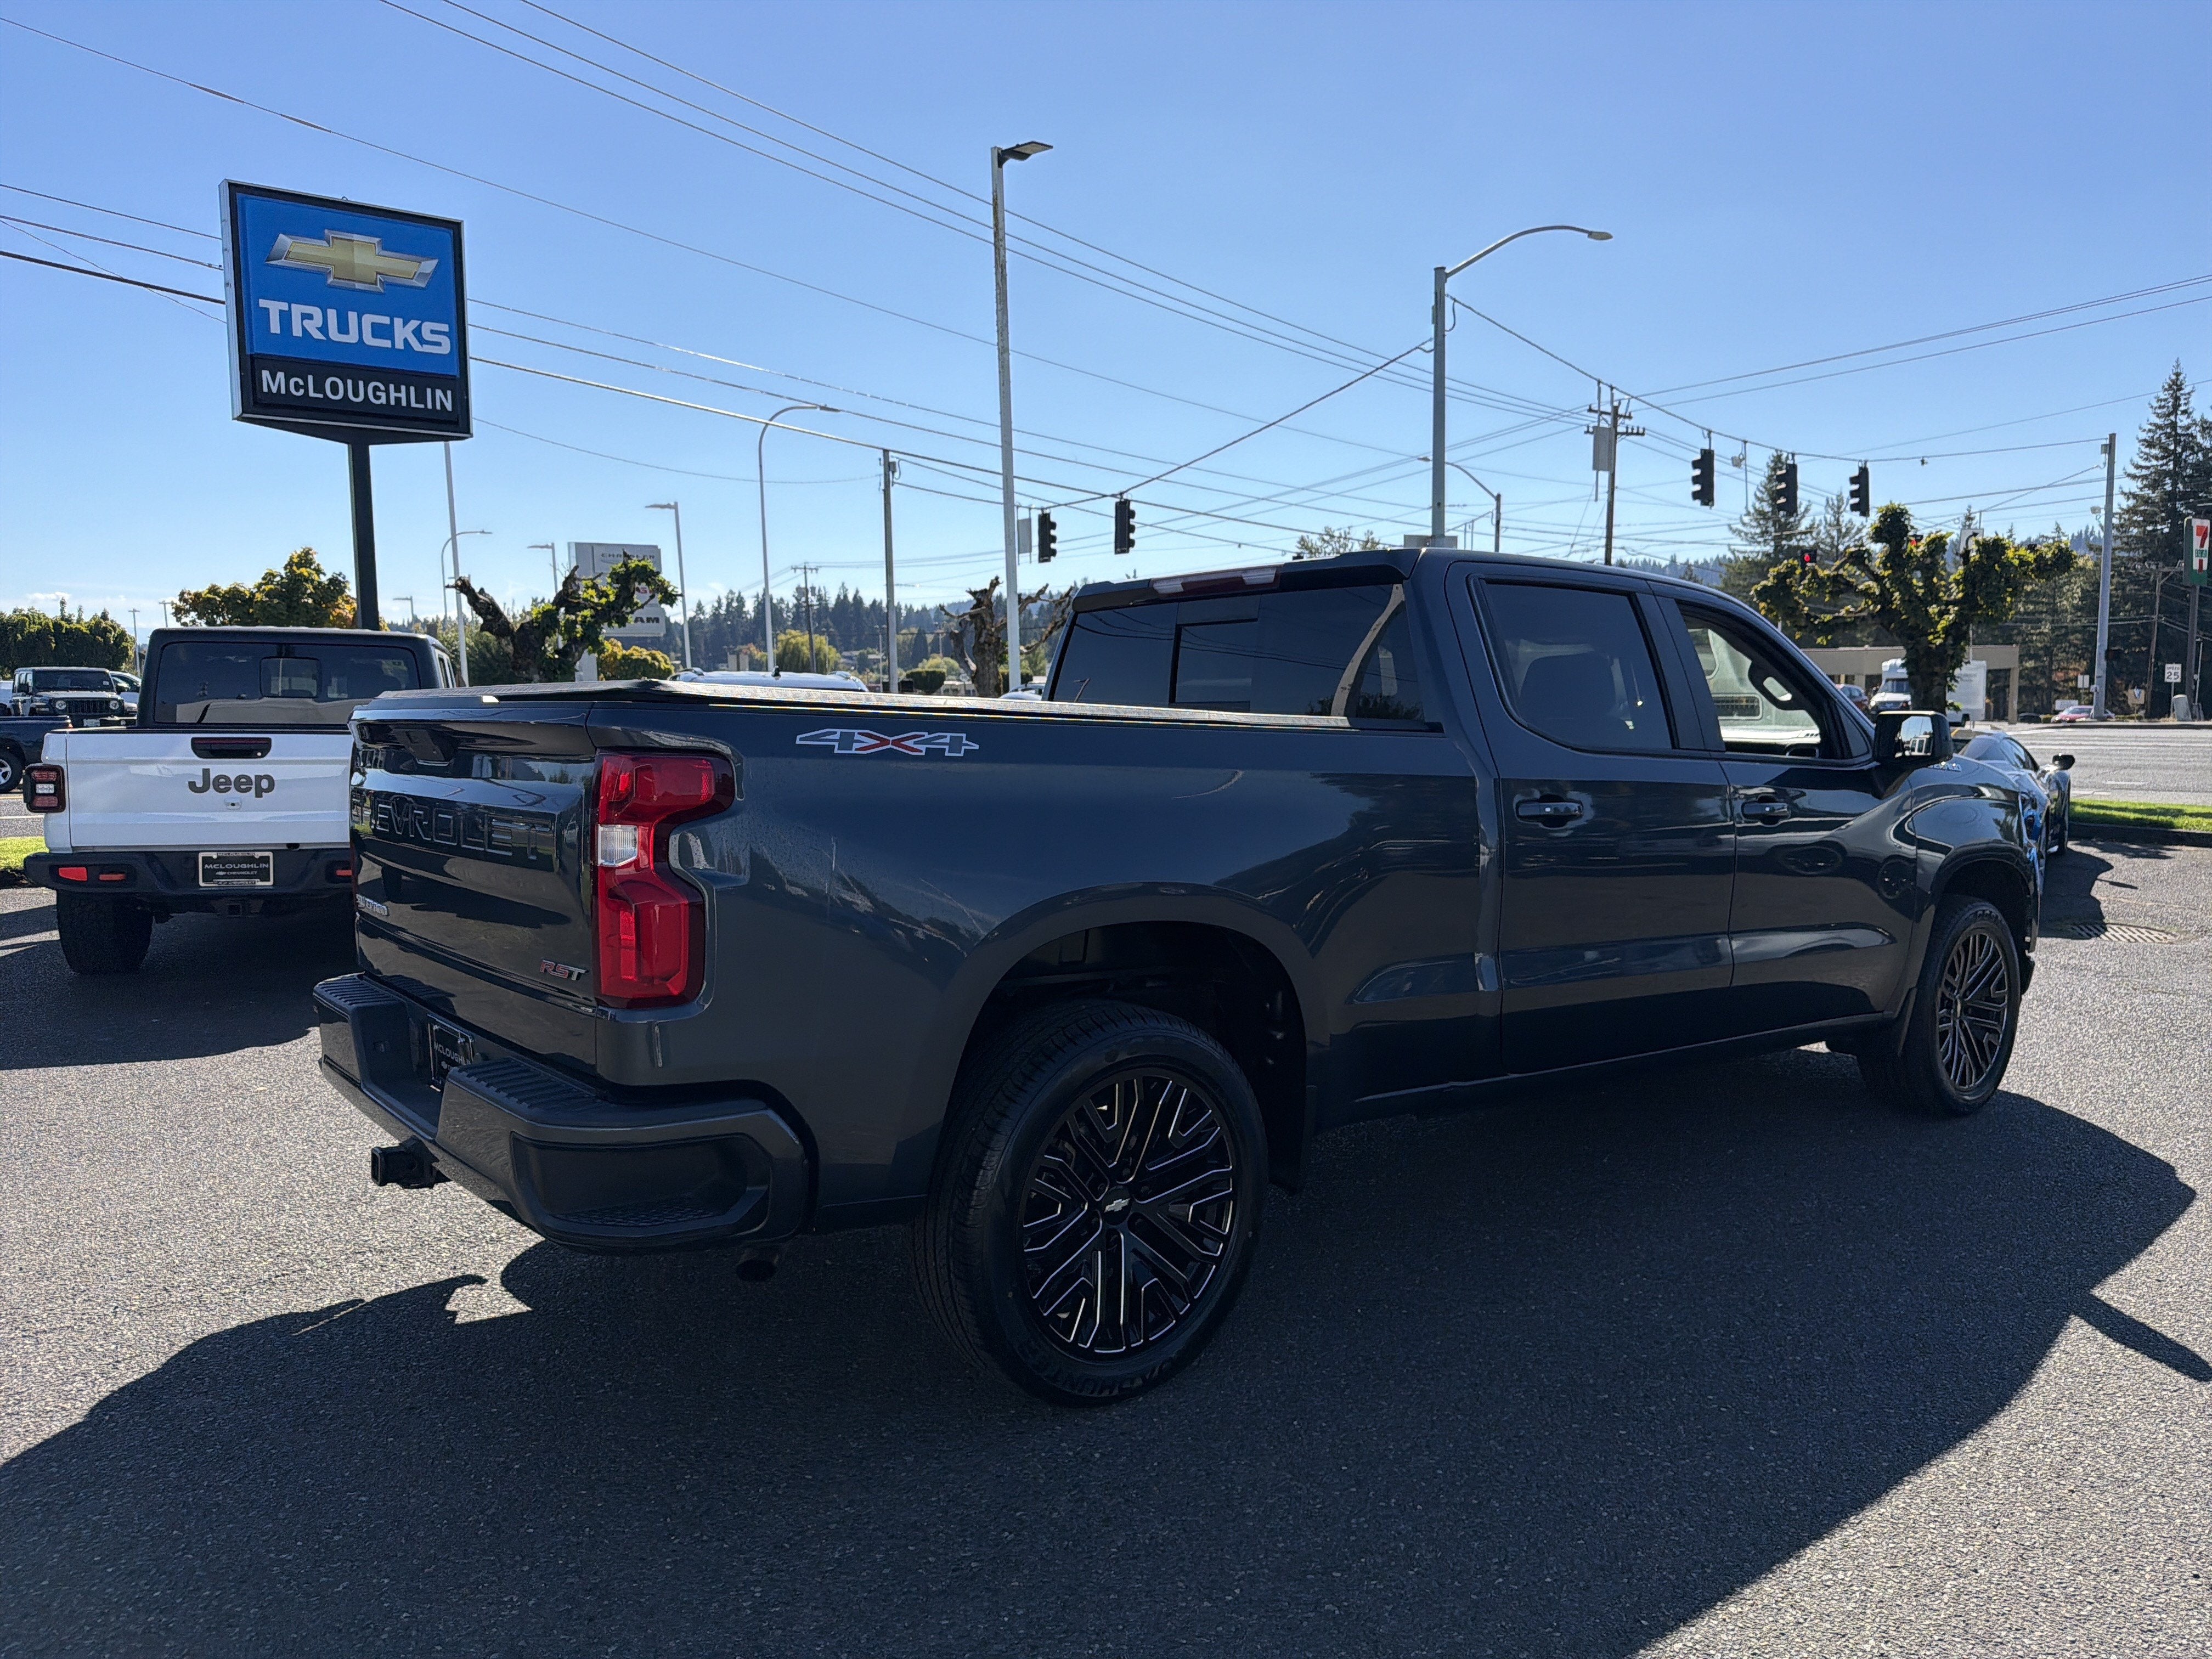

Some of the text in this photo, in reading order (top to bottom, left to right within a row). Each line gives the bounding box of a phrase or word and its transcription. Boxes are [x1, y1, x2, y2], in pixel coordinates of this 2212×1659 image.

[258, 298, 451, 355] TRUCKS
[261, 369, 453, 412] McLOUGHLIN
[2166, 671, 2180, 680] 25
[188, 768, 275, 798] Jeep
[540, 960, 587, 981] RST
